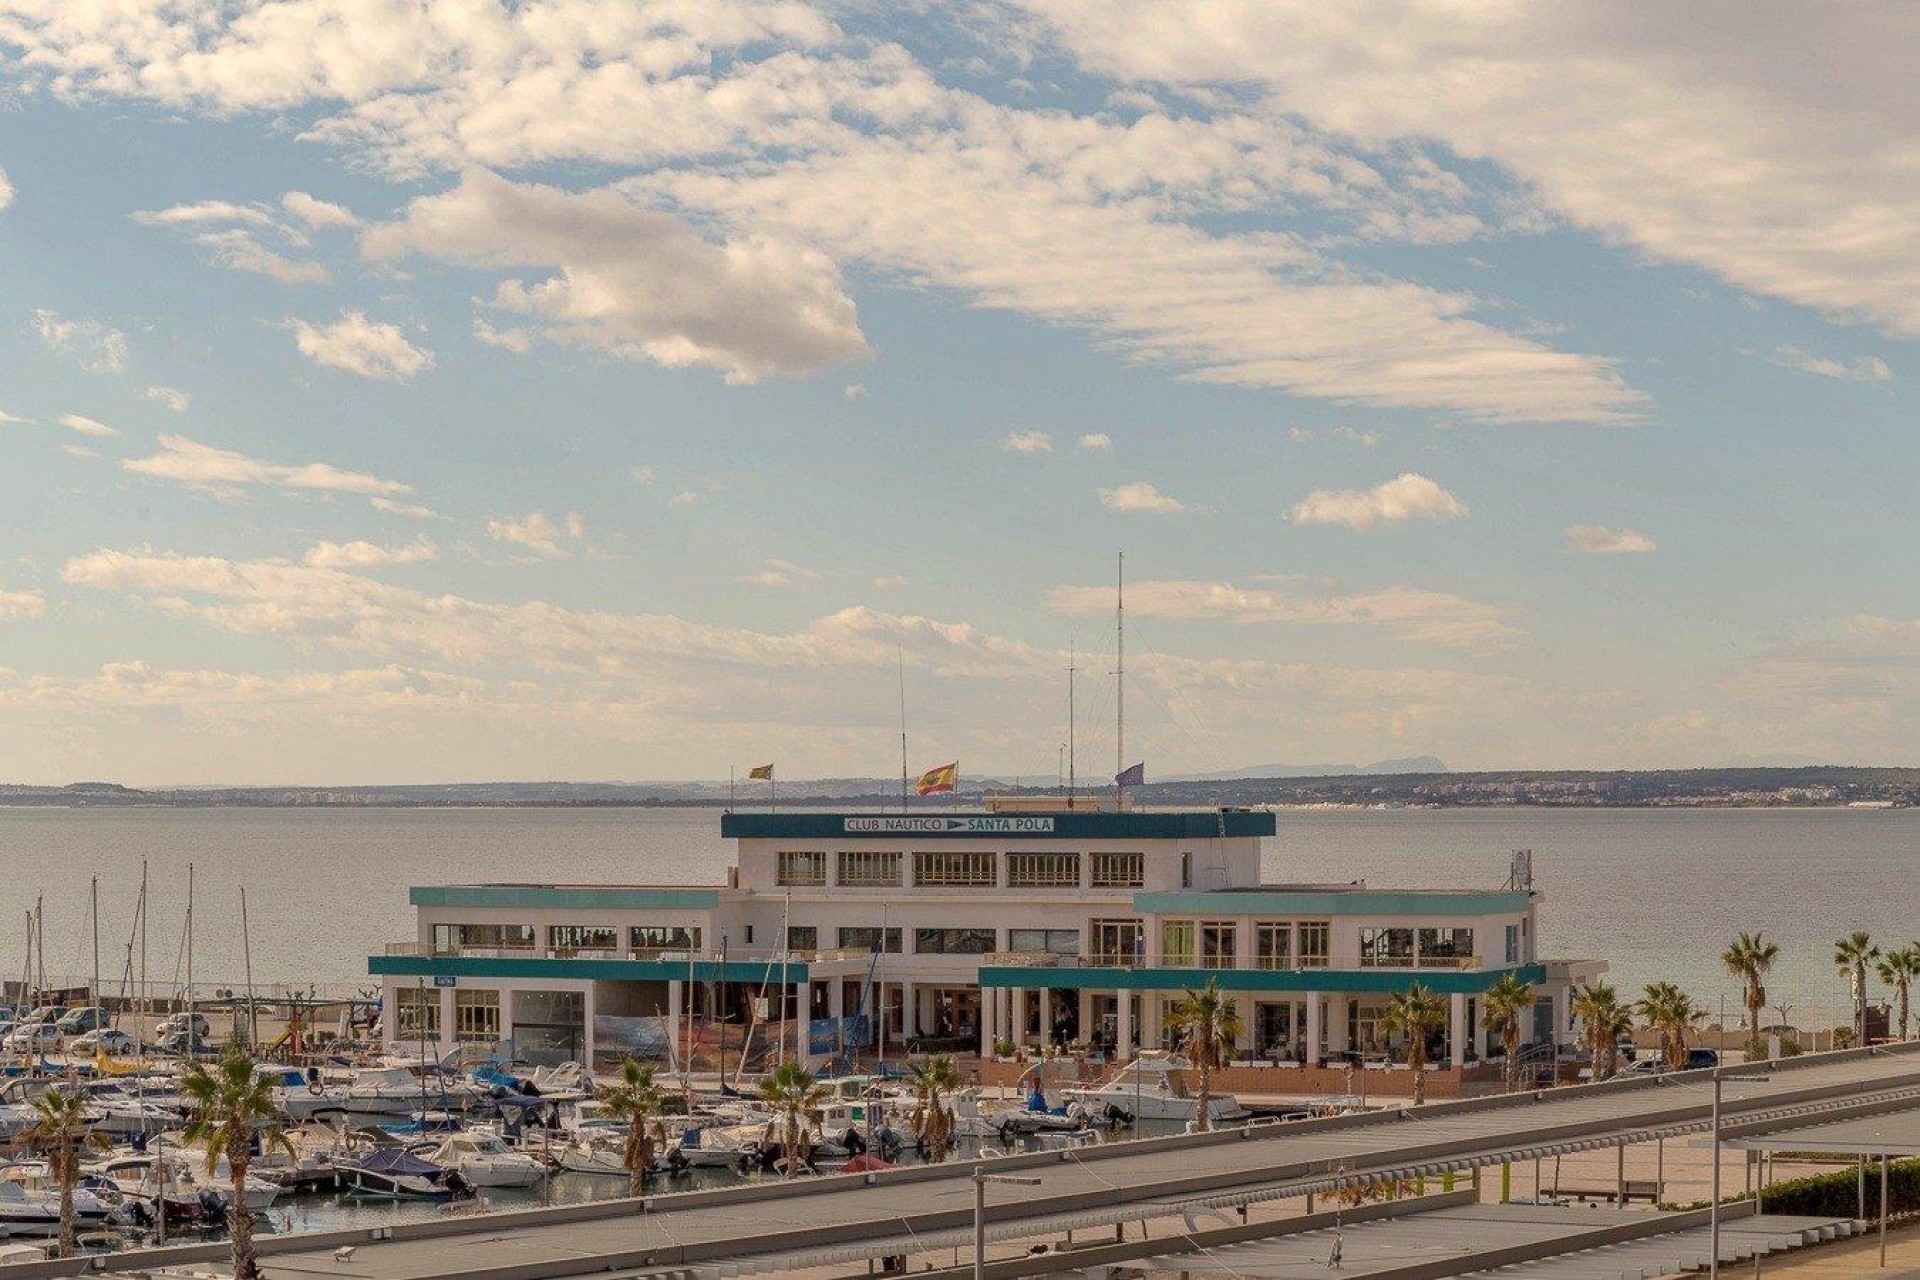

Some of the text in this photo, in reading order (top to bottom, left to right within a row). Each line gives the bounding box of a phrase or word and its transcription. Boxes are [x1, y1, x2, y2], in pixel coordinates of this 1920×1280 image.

[847, 819, 1051, 830] CLUB NAUTICO SANTA POLA
